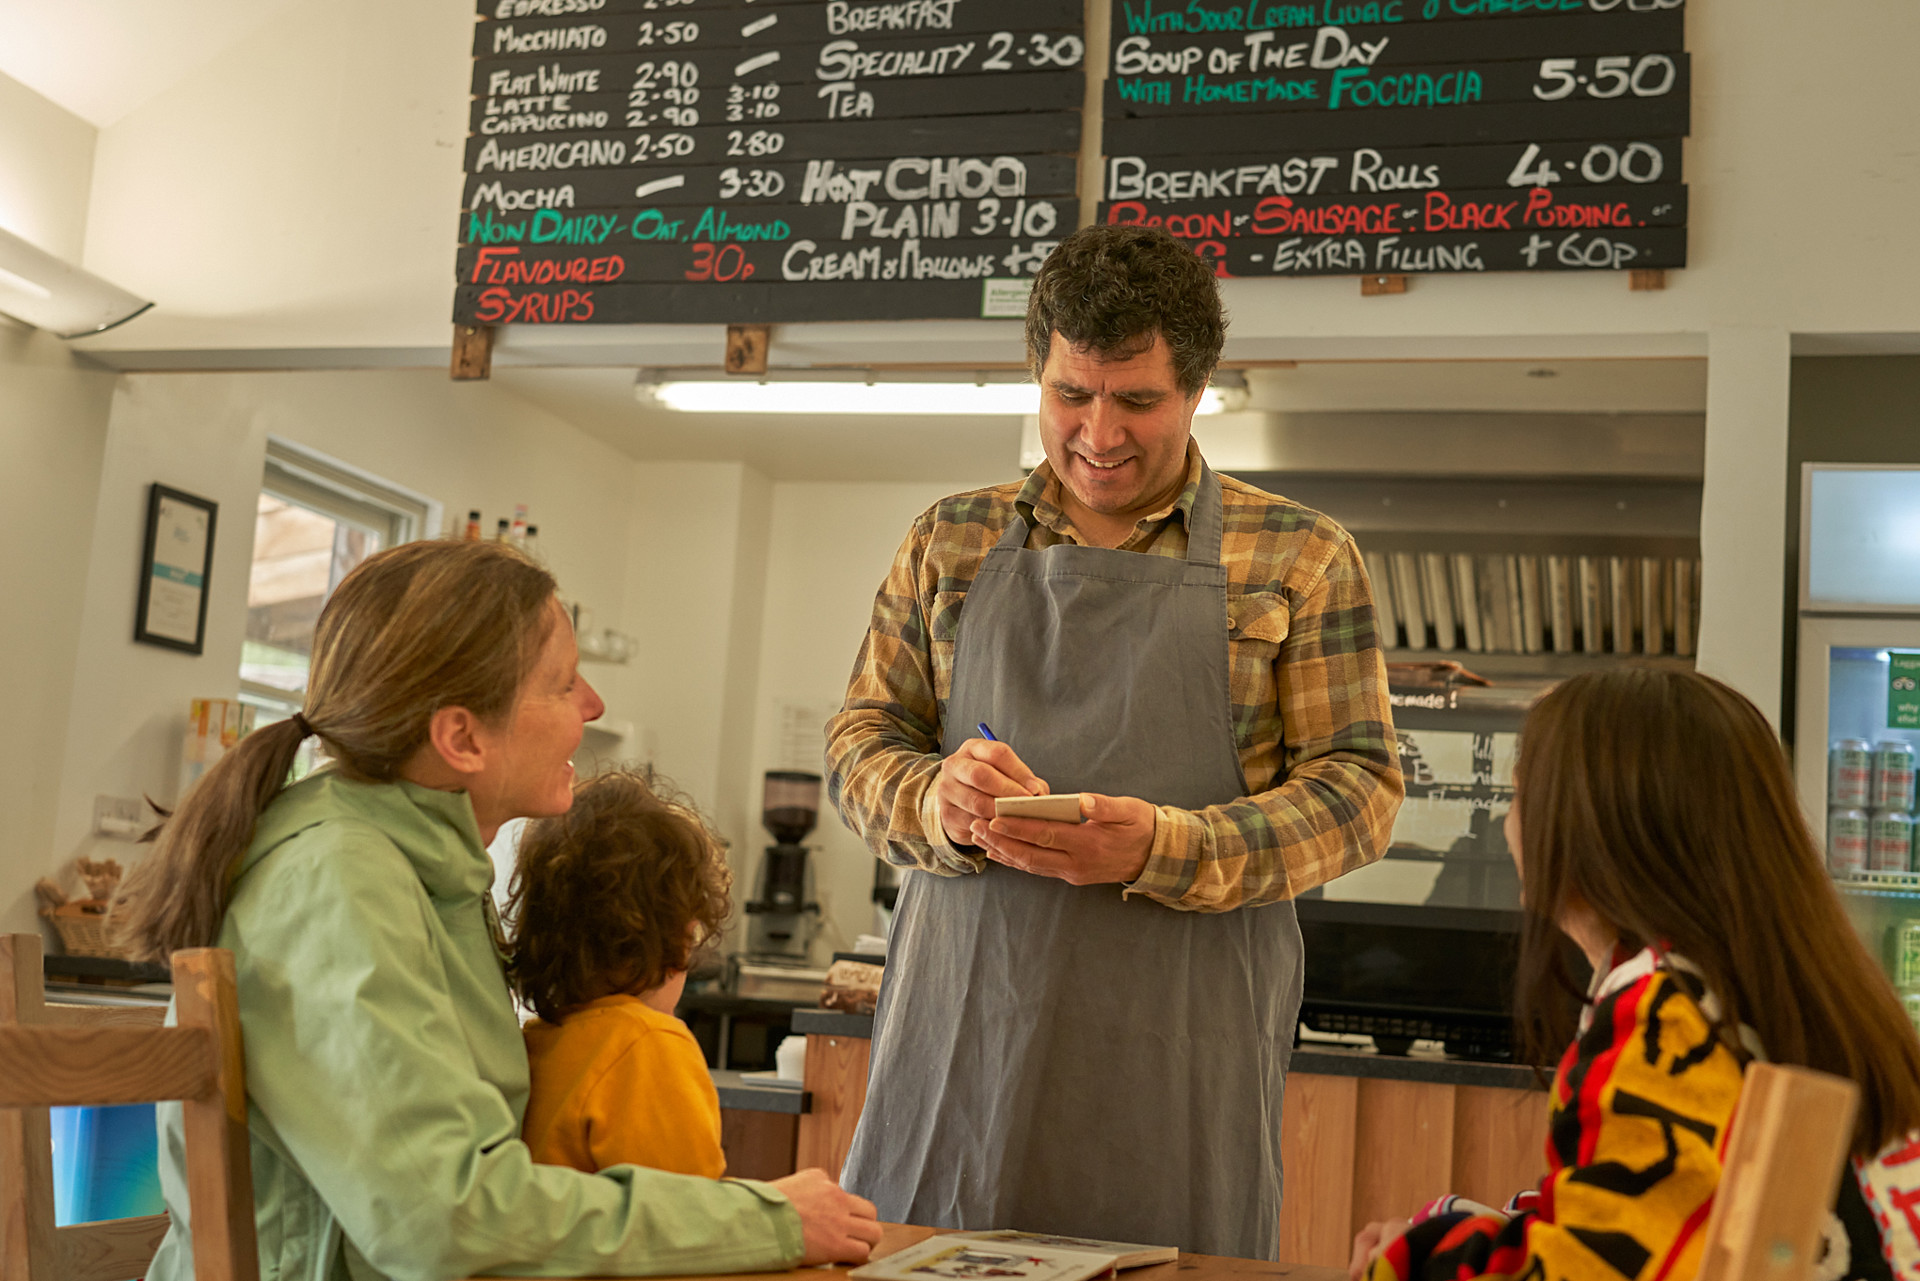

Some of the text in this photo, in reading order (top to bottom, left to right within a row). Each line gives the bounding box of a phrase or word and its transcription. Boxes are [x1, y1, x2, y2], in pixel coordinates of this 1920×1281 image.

[826, 0, 962, 35] BREAKFAST
[1123, 0, 1183, 34] WITH
[816, 40, 975, 81] SPECIALITY
[1115, 26, 1390, 75] SOUP OF THE DAY
[489, 70, 536, 95] FLAT
[537, 63, 601, 94] WHITE
[1117, 76, 1172, 105] WITH
[1183, 74, 1320, 105] HOMEMADE
[1328, 67, 1483, 109] FOCCACIA
[485, 94, 572, 116] LATTE
[817, 82, 875, 119] TEA
[480, 111, 609, 135] CAPPUCCINO
[475, 139, 627, 173] AMERICANO
[1109, 155, 1338, 200] BREAKFAST
[1350, 148, 1440, 193] ROLLS
[470, 181, 575, 211] MOCHA
[801, 159, 883, 203] HOT
[468, 207, 526, 244] NON
[692, 206, 790, 242] ALMOND
[841, 201, 960, 240] PLAIN
[1425, 191, 1518, 232] BLACK
[471, 246, 625, 284] FLAVOURED
[781, 239, 881, 281] CREAM
[899, 239, 996, 279] MALLOWS
[1273, 237, 1365, 272] EXTRA
[1377, 237, 1485, 271] FILLING
[475, 286, 595, 324] SYRUPS
